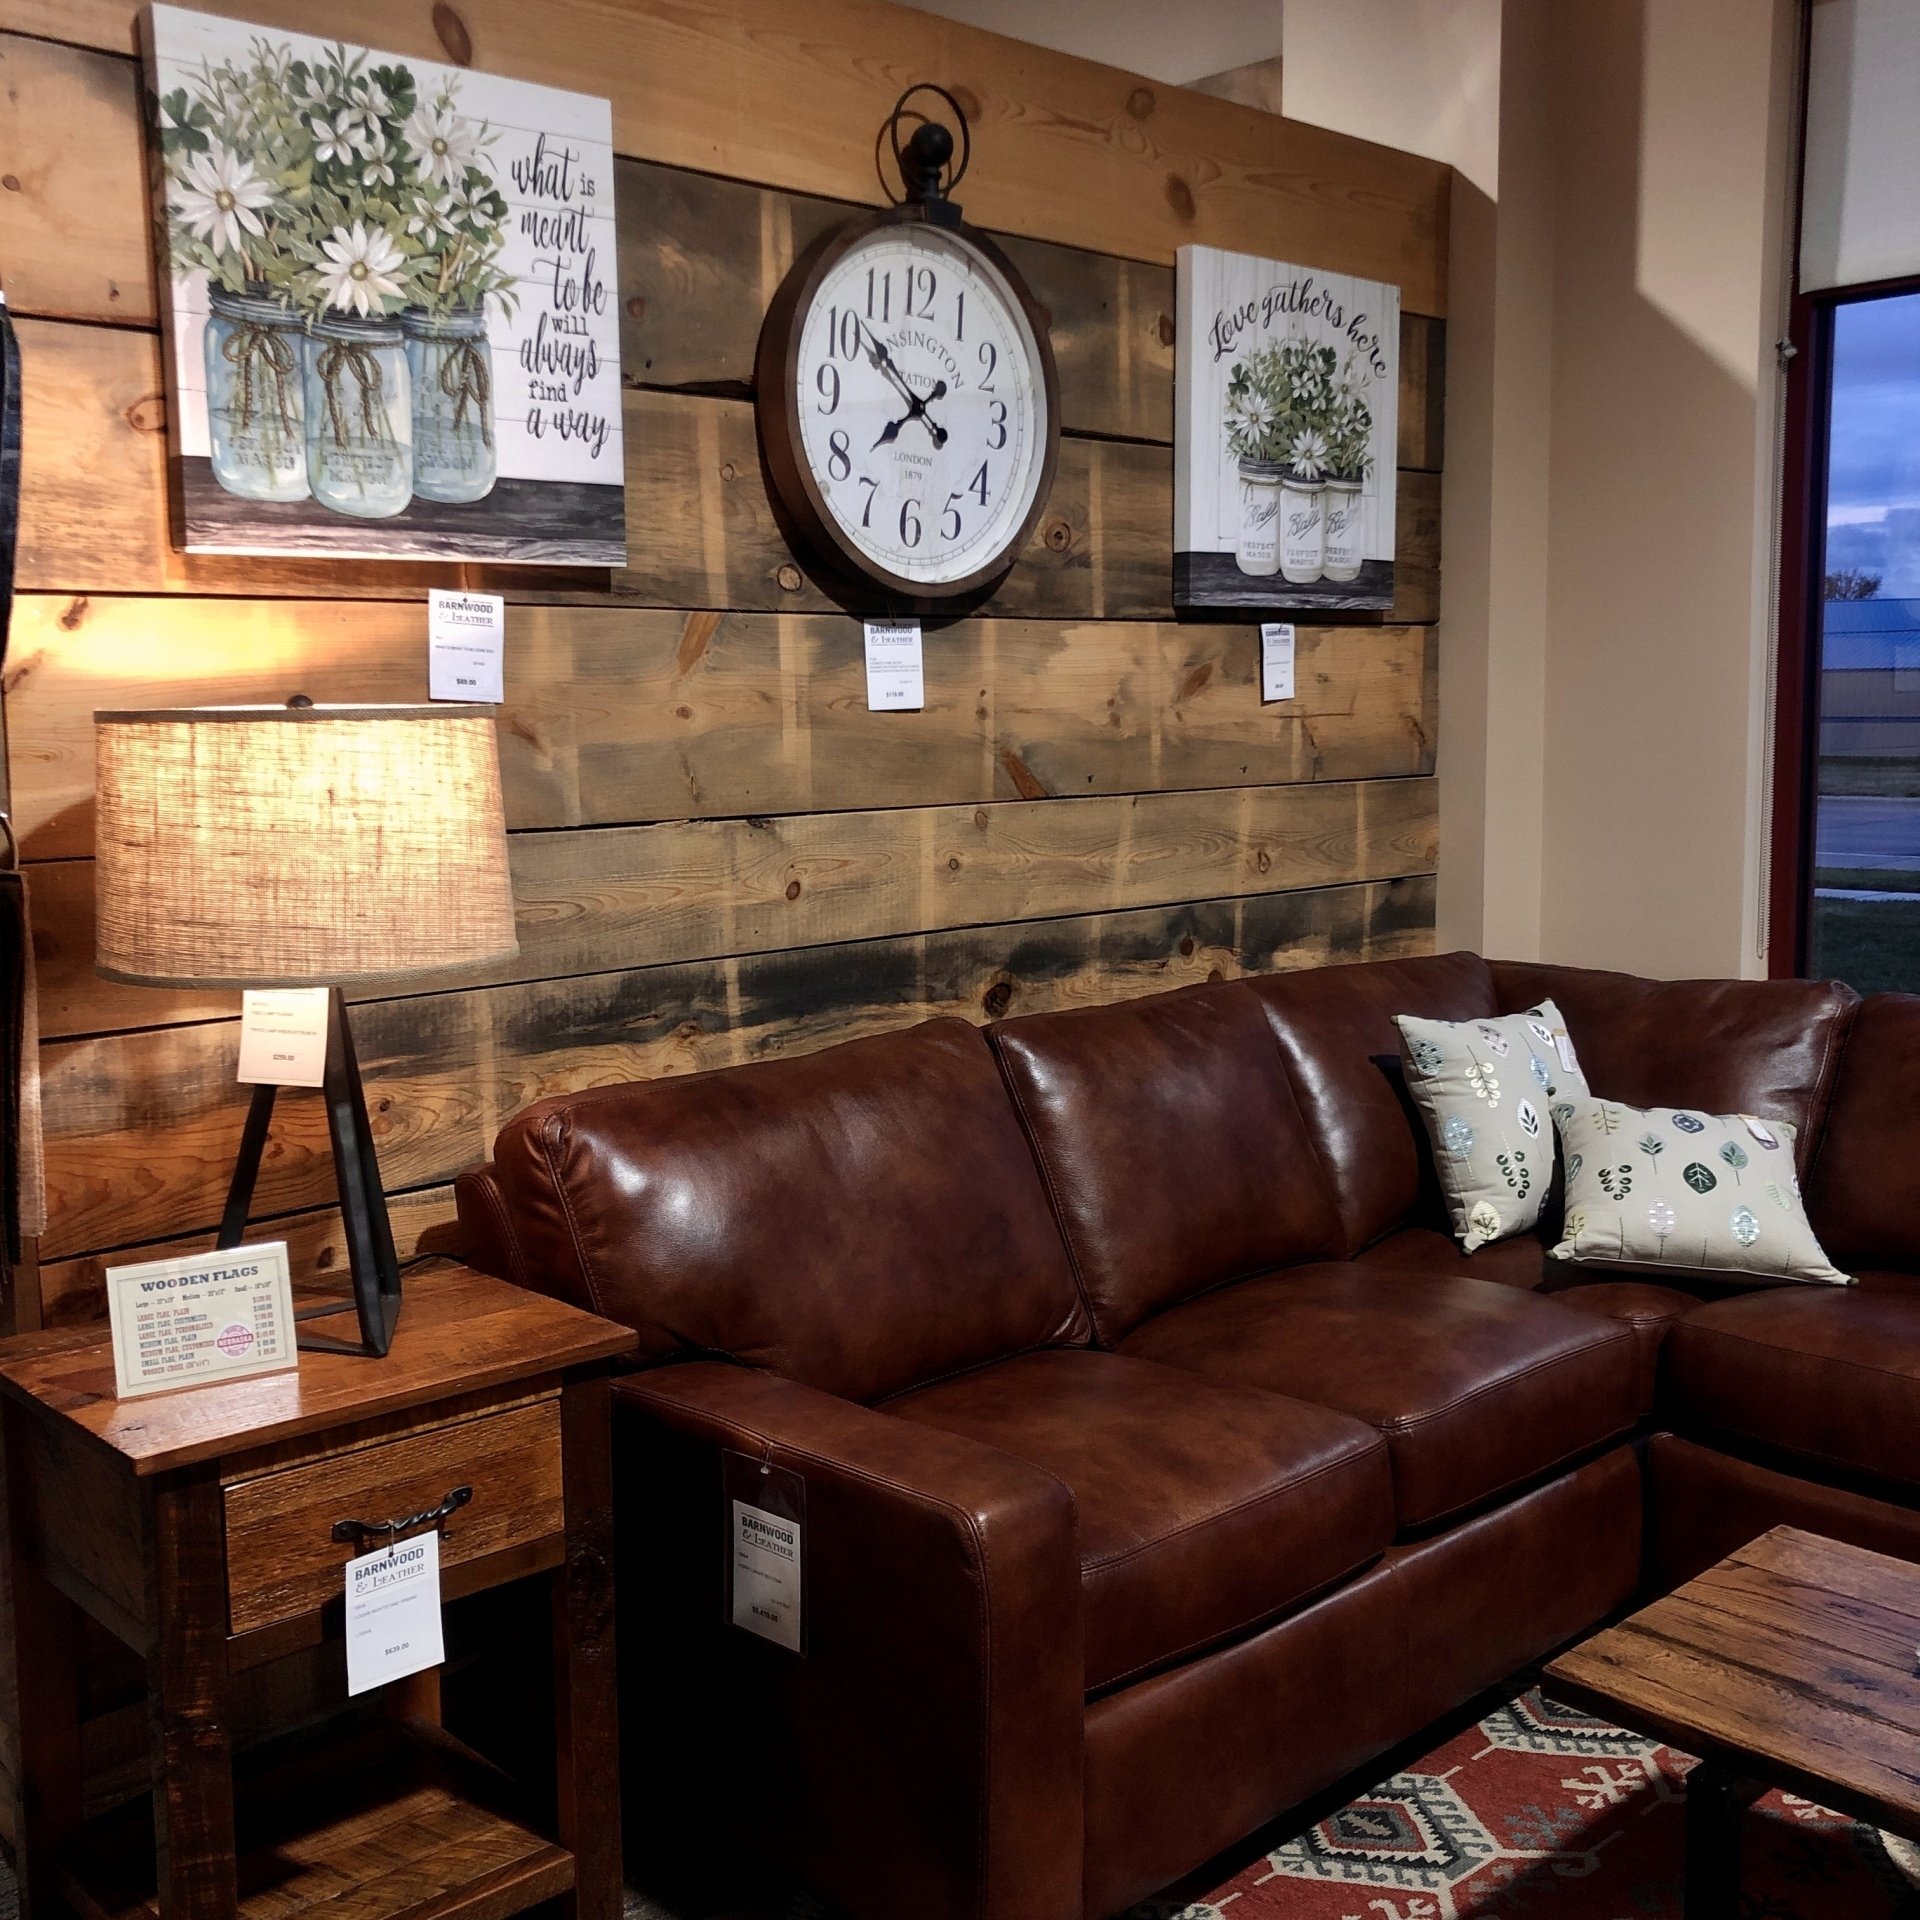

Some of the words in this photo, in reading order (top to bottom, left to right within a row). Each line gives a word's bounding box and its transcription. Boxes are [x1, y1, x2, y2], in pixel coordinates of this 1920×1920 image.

[512, 132, 579, 201] what
[580, 175, 595, 197] is
[521, 205, 594, 252] meant
[532, 255, 577, 311] to
[582, 248, 606, 315] be
[865, 267, 890, 324] 11
[905, 264, 936, 321] 12
[552, 316, 589, 336] will
[828, 305, 861, 362] 10
[954, 291, 965, 343] 1
[1208, 302, 1258, 362] Love
[1262, 277, 1346, 329] gathers
[1346, 313, 1386, 379] here
[520, 311, 600, 395] always
[886, 331, 965, 390] NSINGTON
[978, 342, 997, 393] 2
[528, 380, 568, 402] find
[816, 364, 841, 415] 9
[894, 370, 941, 389] TATION
[527, 407, 546, 438] a
[554, 409, 610, 459] way
[987, 401, 1008, 451] 3
[828, 430, 851, 482] 8
[894, 452, 933, 467] LONDON
[904, 470, 922, 481] 1879
[858, 477, 881, 528] 7
[968, 460, 991, 507] 4
[899, 499, 922, 548] 6
[941, 493, 963, 541] 5
[439, 601, 493, 613] BARNWOOD
[870, 626, 913, 634] BARNWOOD
[882, 636, 913, 644] LEATHER
[140, 1273, 209, 1292] WOODEN
[213, 1266, 259, 1281] FLAGS
[137, 1314, 154, 1322] LARGE
[173, 1308, 190, 1316] PLAIN
[138, 1322, 154, 1331] LARGE
[138, 1332, 156, 1340] LARGE
[182, 1334, 197, 1342] PLAIN
[178, 1352, 194, 1360] PLAIN
[742, 1516, 794, 1545] BARNWOOD
[742, 1529, 752, 1541] &
[754, 1536, 794, 1558] LEATHER
[356, 1548, 424, 1580] BARNWOOD
[356, 1581, 368, 1593] &
[373, 1563, 424, 1588] LEATHER
[385, 1642, 409, 1656] $639.00
